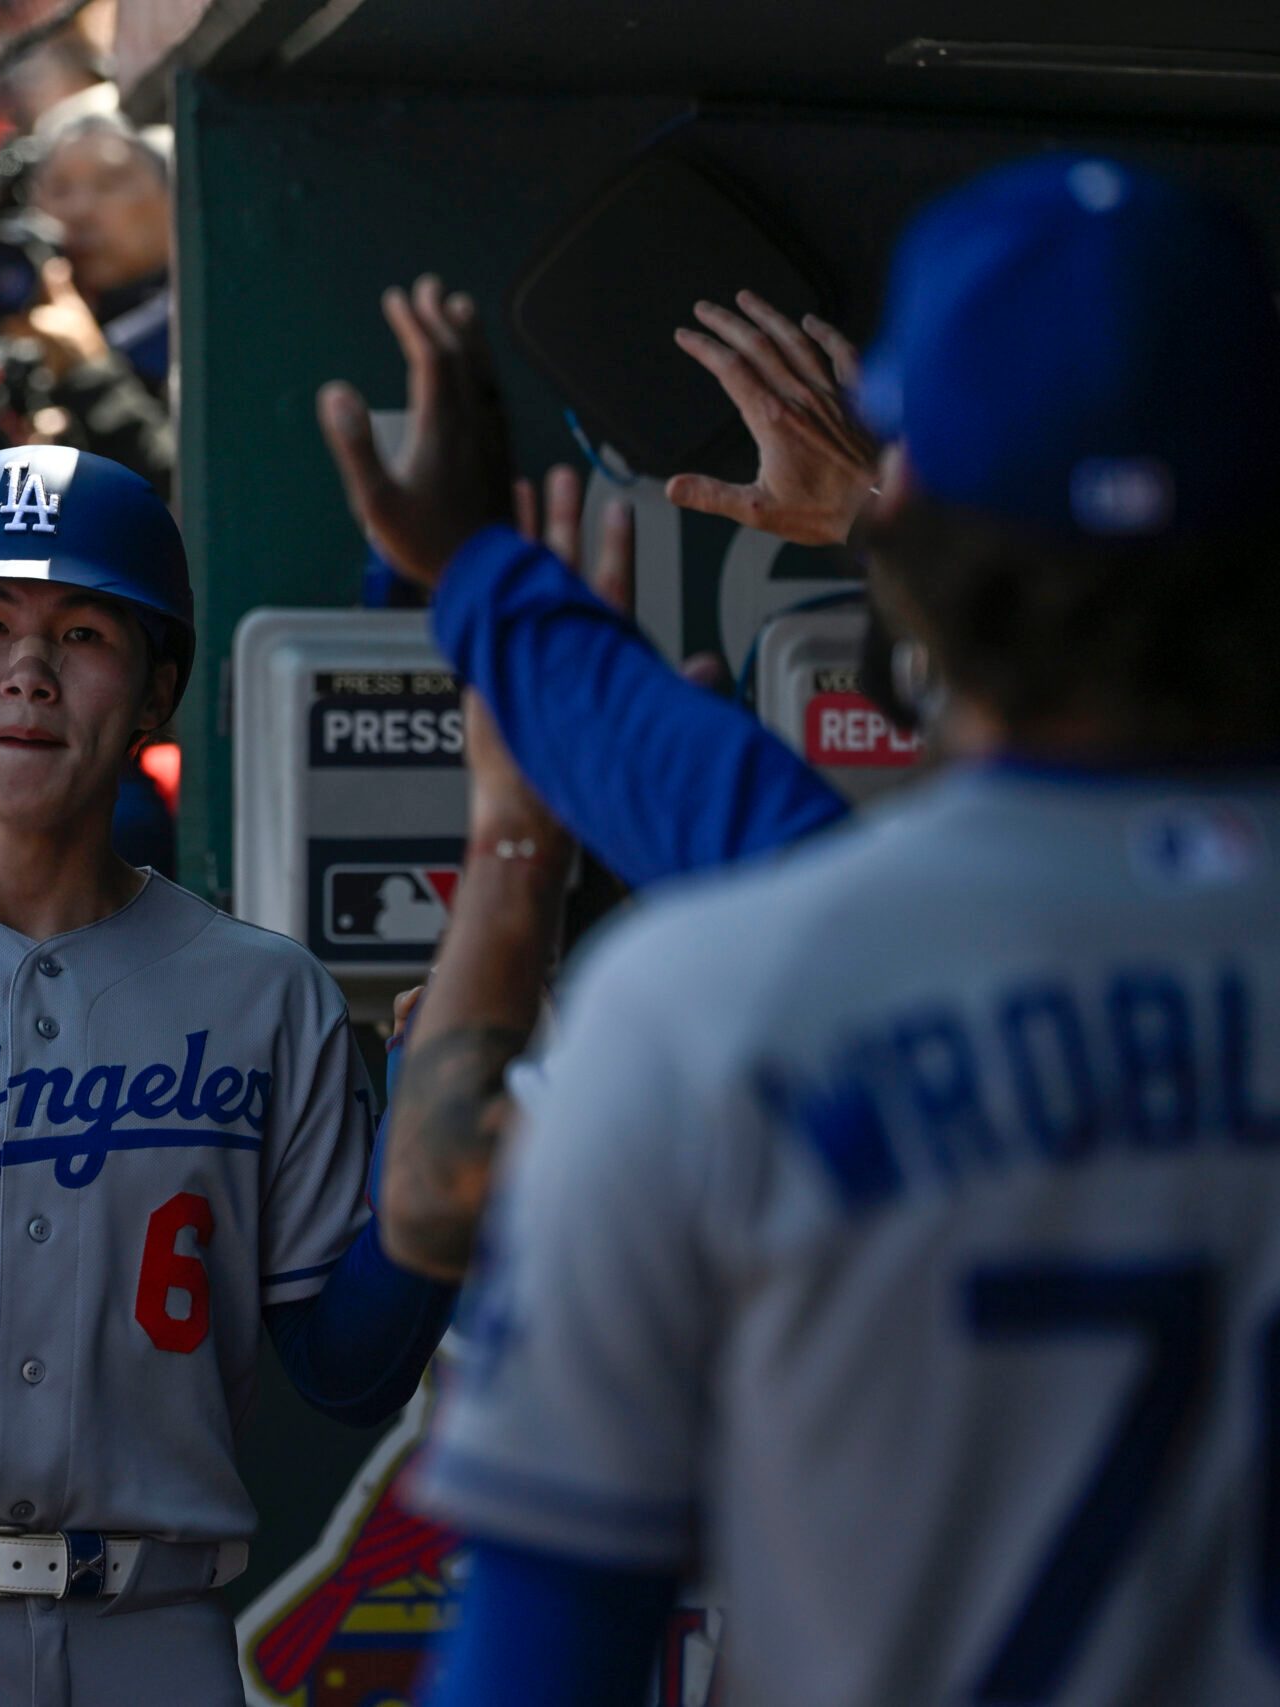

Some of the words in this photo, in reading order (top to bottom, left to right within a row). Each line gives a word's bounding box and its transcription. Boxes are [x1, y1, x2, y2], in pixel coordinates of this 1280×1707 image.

[0, 461, 60, 534] LA
[332, 674, 404, 695] PRESS
[322, 708, 464, 754] PRESS
[819, 708, 918, 754] REPL
[135, 1191, 216, 1355] 6
